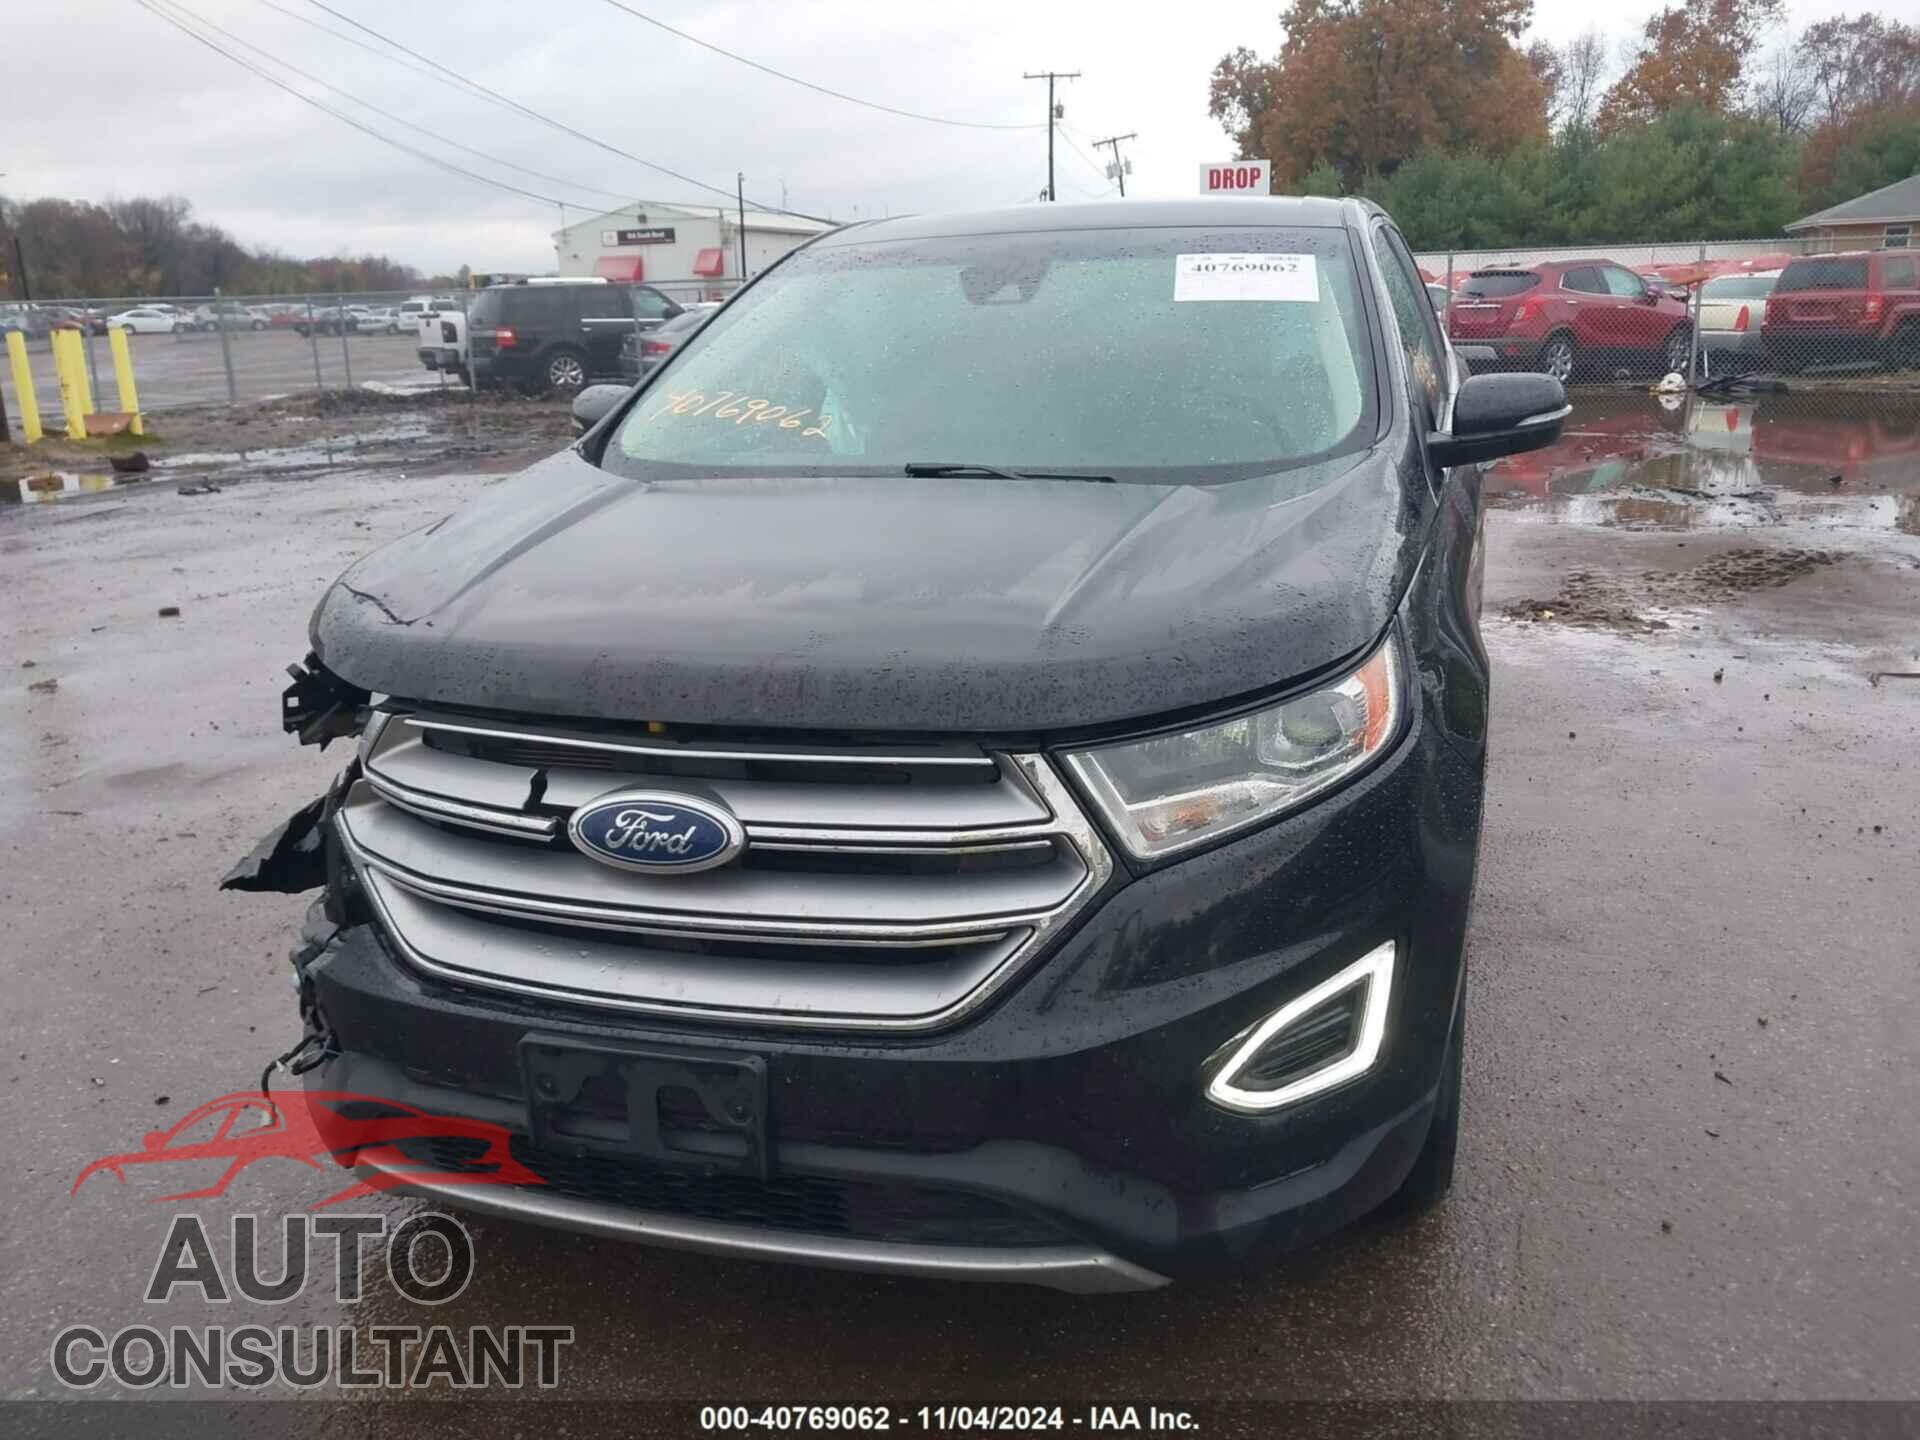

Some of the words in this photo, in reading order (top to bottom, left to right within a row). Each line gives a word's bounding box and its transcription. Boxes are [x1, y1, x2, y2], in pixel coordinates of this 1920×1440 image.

[1209, 167, 1261, 190] DROP
[1191, 262, 1299, 273] 40769062
[605, 809, 697, 855] Ford
